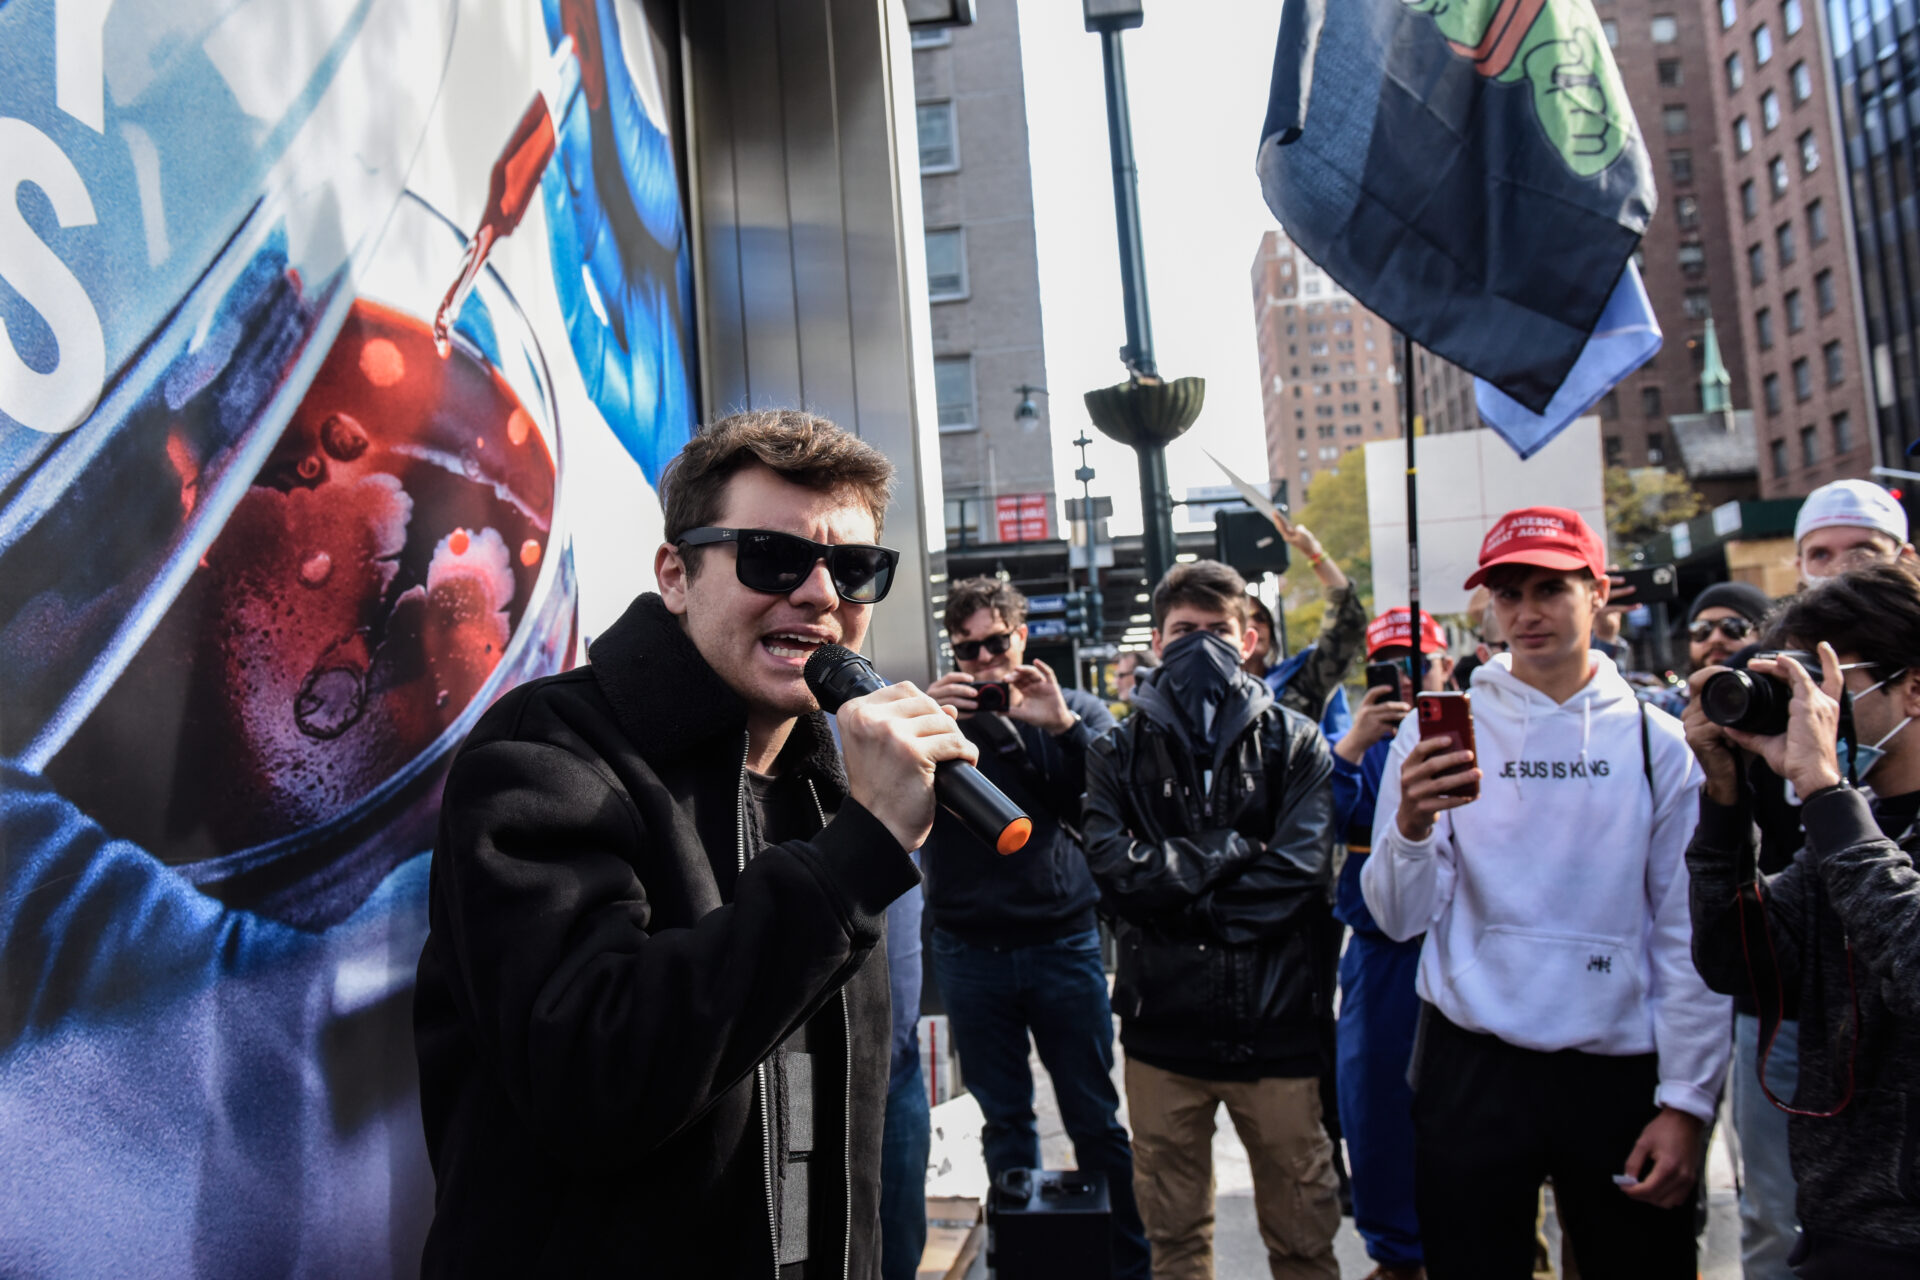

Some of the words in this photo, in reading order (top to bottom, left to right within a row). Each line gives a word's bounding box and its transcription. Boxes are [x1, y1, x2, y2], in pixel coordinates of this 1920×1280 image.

[1509, 516, 1565, 530] AMERICA
[1517, 527, 1558, 537] AGAIN
[1499, 761, 1549, 779] JESUS
[1551, 761, 1567, 779] IS
